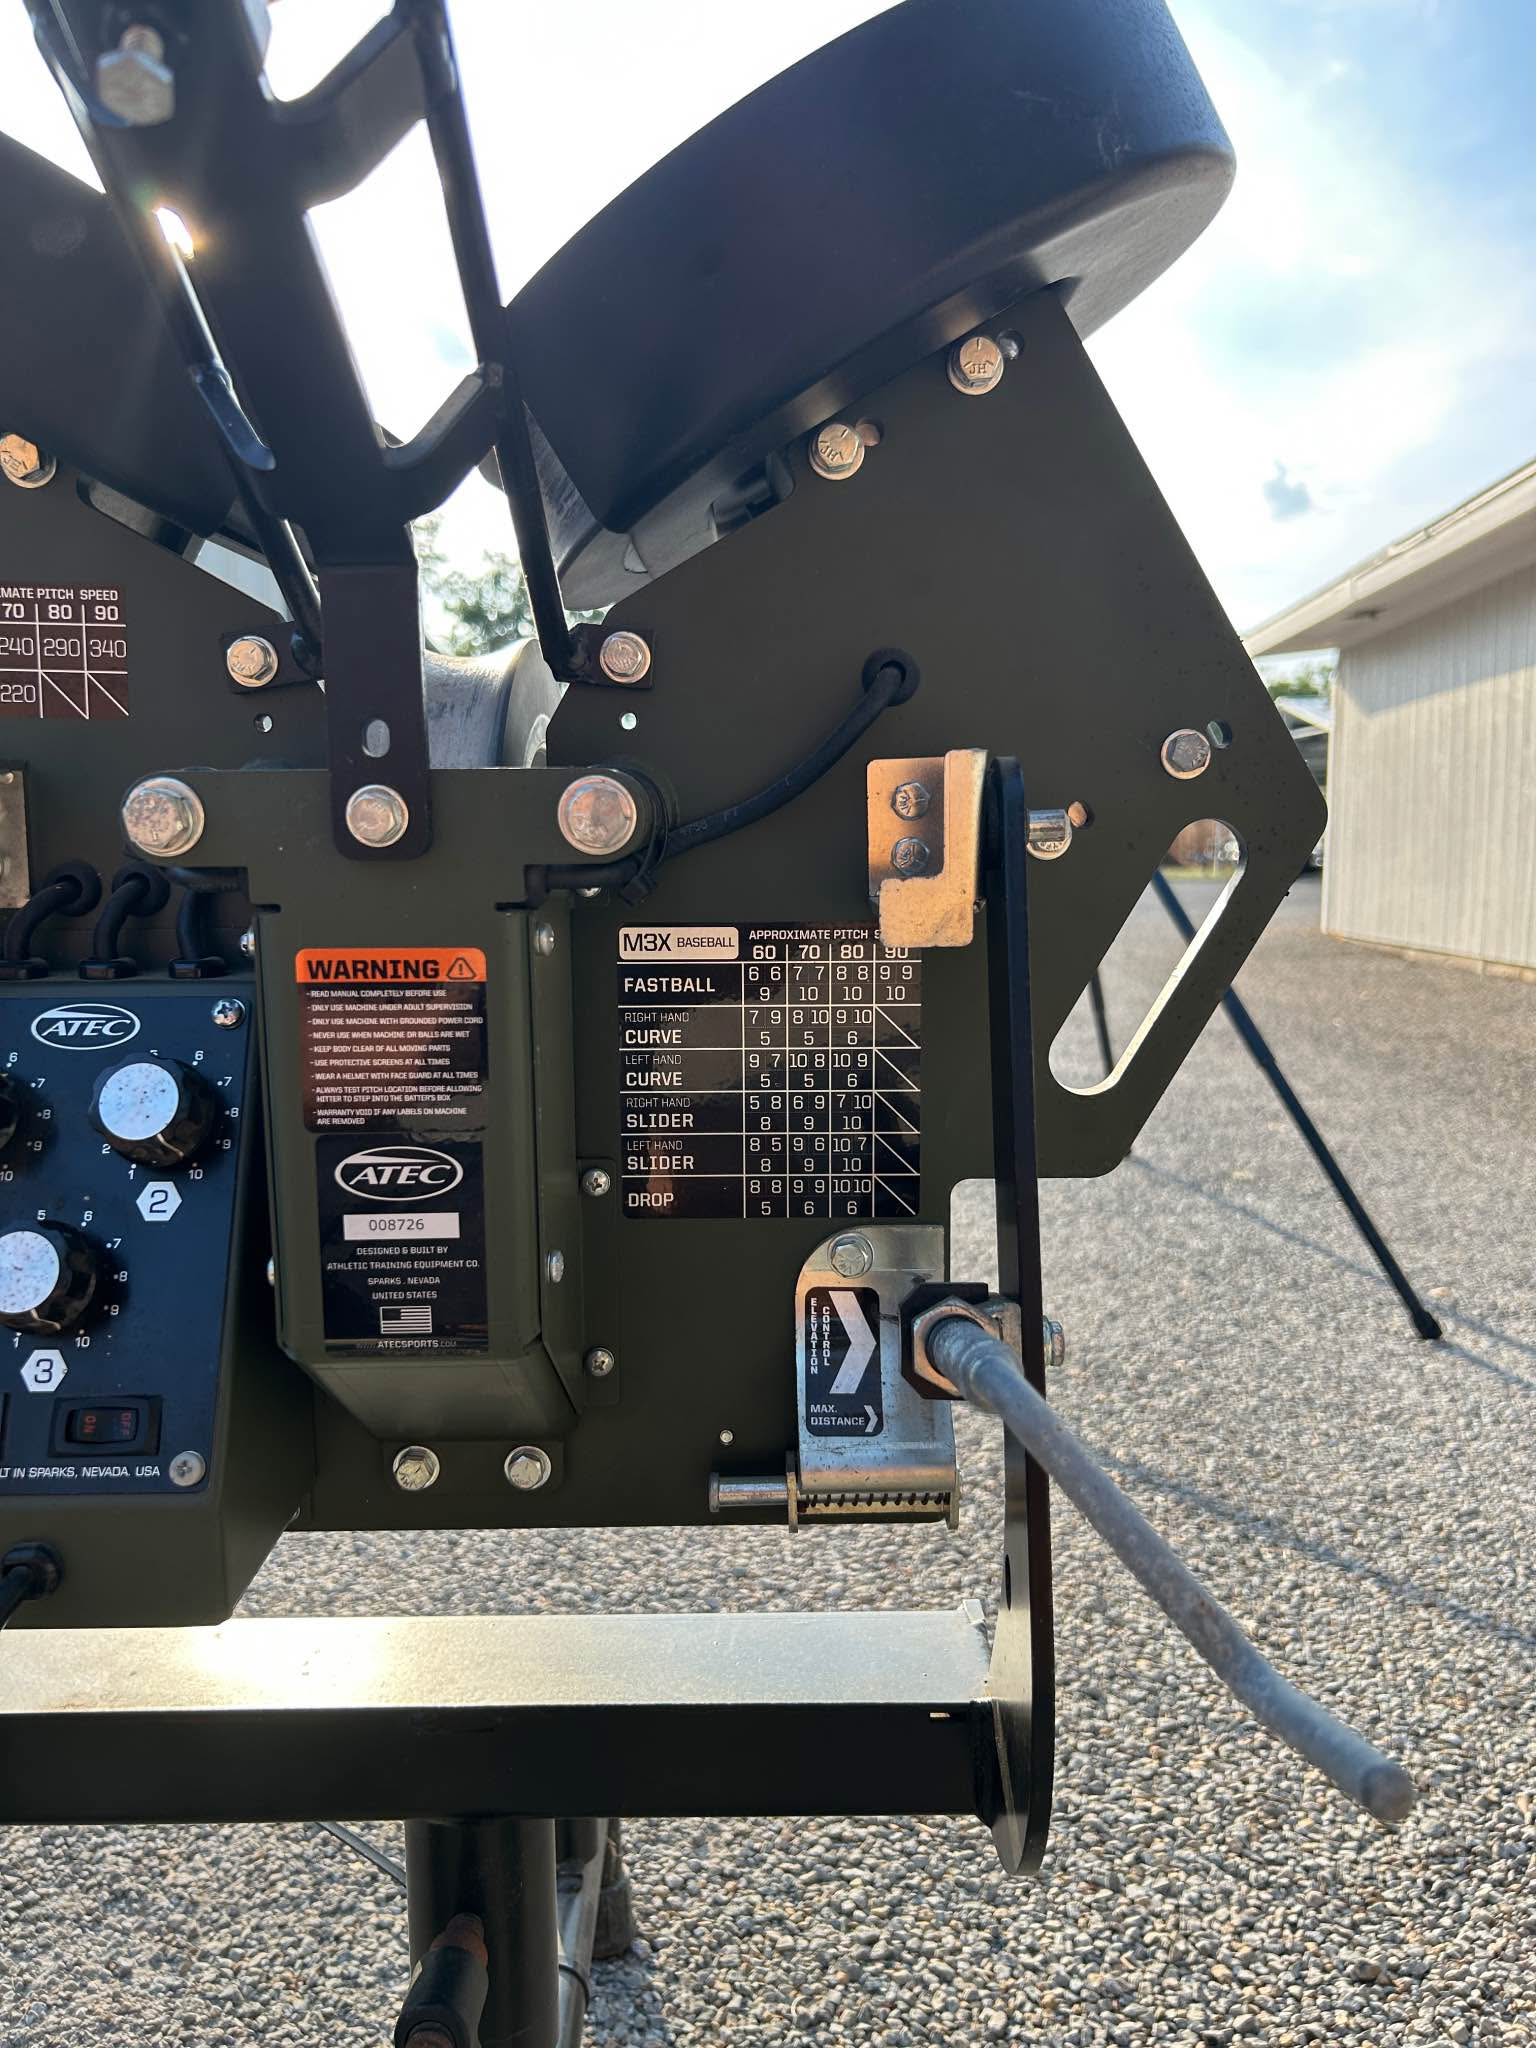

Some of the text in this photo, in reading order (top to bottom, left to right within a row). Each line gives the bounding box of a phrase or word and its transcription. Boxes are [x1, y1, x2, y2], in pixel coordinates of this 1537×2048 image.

[37, 588, 74, 600] PITCH
[80, 590, 118, 600] SPEED
[2, 603, 118, 620] 70 80 90
[0, 638, 126, 658] 240 290 340
[0, 684, 36, 702] 220
[749, 929, 831, 940] APPROXIMATE
[833, 929, 868, 940] PITCH
[623, 933, 735, 951] M3X BASEBALL
[752, 946, 776, 960] 60
[799, 945, 820, 959] 70
[840, 945, 864, 959] 80
[307, 960, 440, 980] WARNING
[748, 966, 912, 981] 6 6 7 7 8 8 9 9
[624, 977, 715, 993] FASTBALL
[311, 990, 447, 998] READ MANUAL COMPLETELY BEFORE USE
[759, 986, 905, 1001] 9 10 10 10
[624, 1012, 689, 1023] RIGHT HAND
[749, 1010, 872, 1025] 7 9 8 10 9 10
[41, 1020, 130, 1036] ATEC
[625, 1029, 682, 1044] CURVE
[760, 1031, 858, 1045] 5 5 6
[10, 1053, 17, 1062] 6
[195, 1051, 203, 1060] 6
[625, 1054, 682, 1065] LEFT HAND
[749, 1053, 868, 1068] 9 7 10 8 10 9
[38, 1079, 45, 1088] 7
[224, 1077, 232, 1086] 7
[626, 1071, 682, 1086] CURVE
[760, 1073, 858, 1088] 5 5 6
[626, 1097, 691, 1108] RIGHT HAND
[42, 1110, 50, 1119] 8
[230, 1108, 238, 1117] 8
[317, 1108, 468, 1116] WARRANTY VOID IF ANY LABELS ON MACHINE
[627, 1113, 694, 1128] SLIDER
[34, 1141, 42, 1150] 9
[102, 1144, 111, 1153] 2
[223, 1140, 231, 1149] 9
[627, 1140, 683, 1151] LEFT HAND
[627, 1155, 695, 1170] SLIDER
[128, 1170, 134, 1179] 1
[189, 1170, 203, 1179] 10
[349, 1165, 452, 1185] ATEC
[150, 1190, 168, 1213] 2
[628, 1193, 674, 1207] DROP
[37, 1211, 46, 1220] 5
[84, 1211, 92, 1221] 6
[369, 1218, 425, 1231] 008726
[113, 1239, 121, 1248] 7
[357, 1246, 448, 1255] DESIGNED & BUILT BY
[327, 1262, 368, 1270] ATHLETIC
[370, 1261, 412, 1269] TRAINING
[414, 1260, 464, 1269] EQUIPMENT
[119, 1272, 128, 1281] 8
[407, 1276, 440, 1284] NEVADA
[372, 1290, 438, 1300] UNITED STATES
[110, 1305, 119, 1315] 9
[76, 1337, 90, 1347] 10
[822, 1307, 830, 1366] CONTROL
[13, 1337, 19, 1348] 1
[34, 1359, 53, 1383] 3
[811, 1404, 837, 1413] MAX.
[811, 1417, 864, 1425] DISTANCE
[13, 1468, 25, 1478] IN
[29, 1467, 78, 1478] SPARKS,
[136, 1466, 160, 1476] USA
